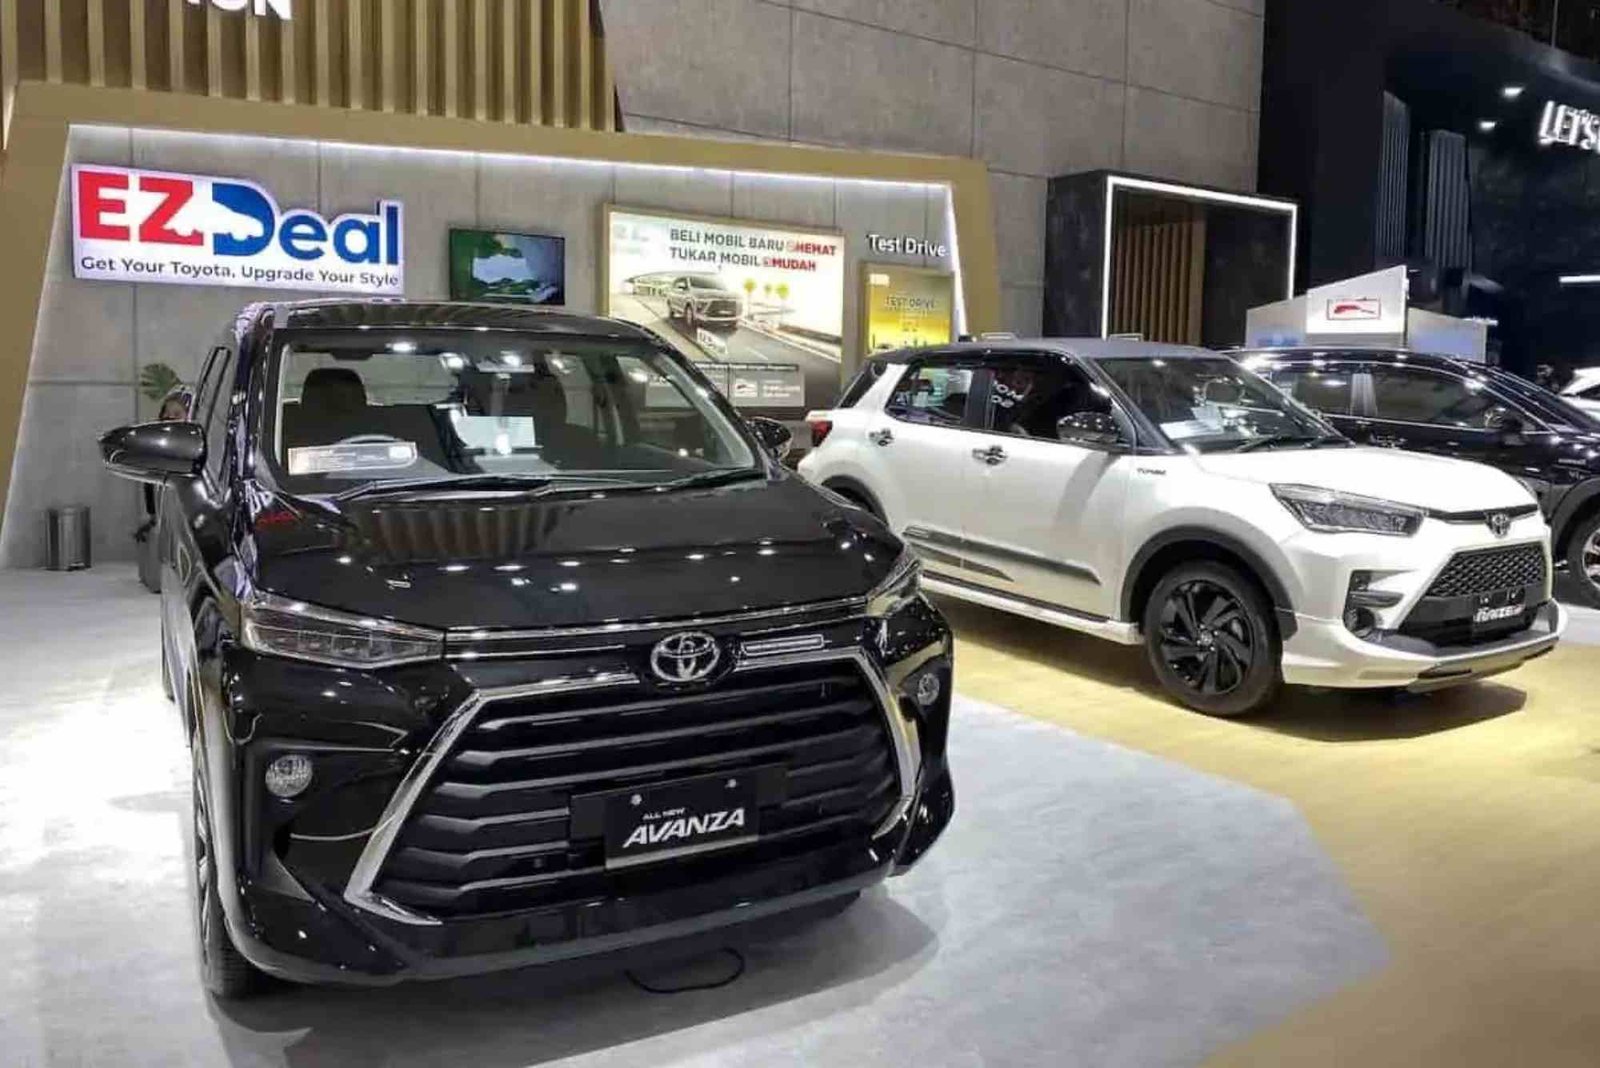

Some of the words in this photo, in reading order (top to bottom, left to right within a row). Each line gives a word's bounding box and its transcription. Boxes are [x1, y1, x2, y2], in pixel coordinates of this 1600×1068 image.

[670, 228, 700, 243] BELI
[704, 232, 745, 247] MOBIL
[749, 237, 784, 251] BARU
[868, 233, 900, 254] Test
[905, 237, 946, 257] Drive
[669, 246, 716, 263] TUKAR
[720, 253, 760, 267] MOBIL
[81, 256, 116, 271] Get
[121, 258, 165, 276] Your
[171, 261, 236, 280] Toyota,
[242, 265, 314, 283] Upgrade
[319, 269, 355, 285] Your
[360, 272, 399, 287] Style
[642, 812, 662, 821] ALL
[662, 807, 686, 817] NEW
[622, 807, 745, 849] AVANZA
